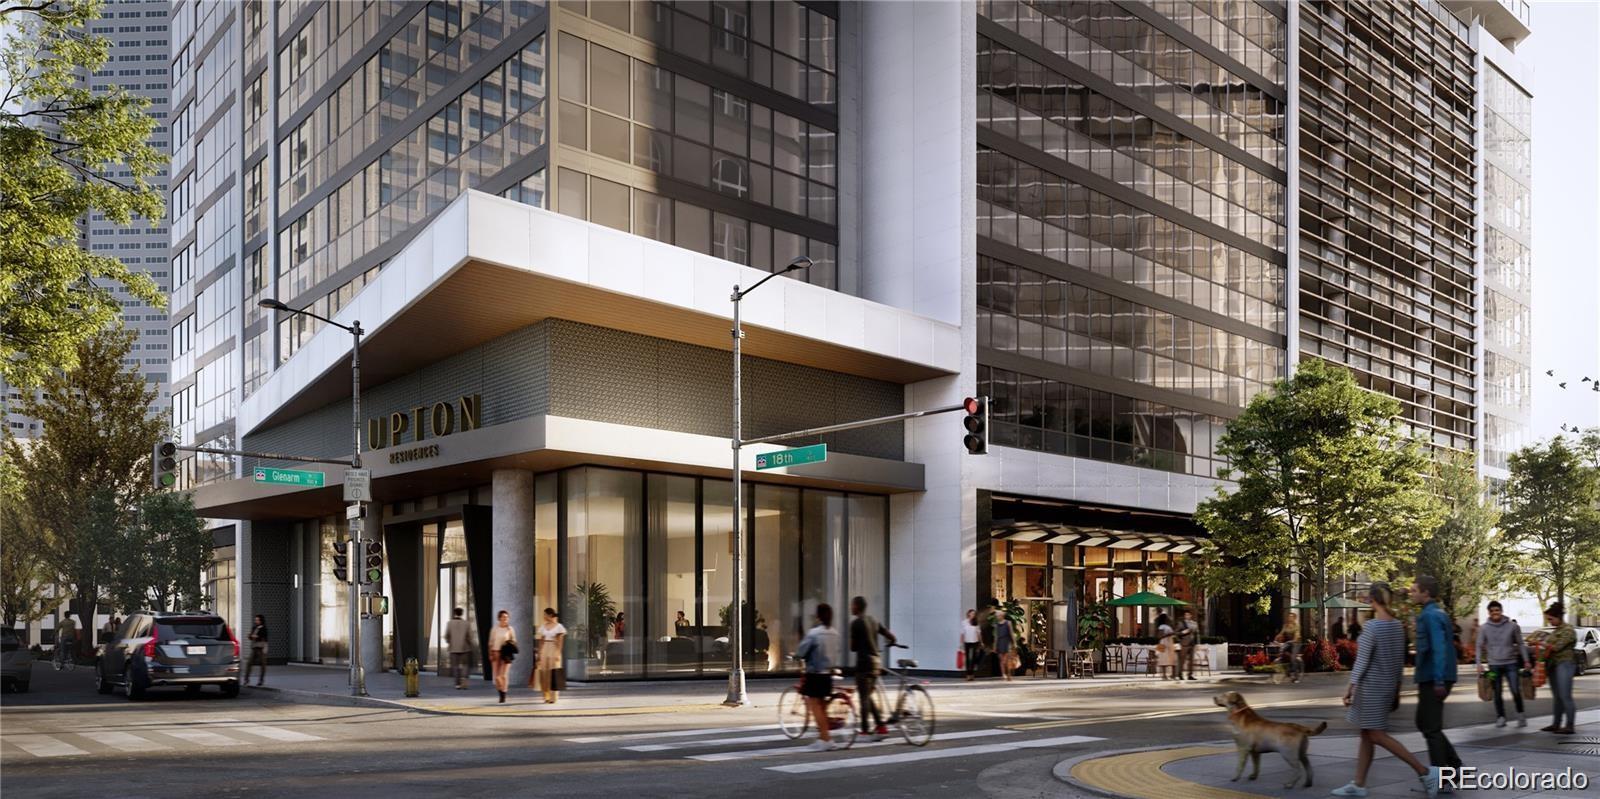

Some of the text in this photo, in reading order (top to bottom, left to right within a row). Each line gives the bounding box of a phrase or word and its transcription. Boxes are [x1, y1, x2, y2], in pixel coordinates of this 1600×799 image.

[368, 393, 481, 451] UPTON
[389, 444, 440, 464] RESIDENCES
[772, 454, 793, 465] 18th
[272, 470, 300, 483] Glenarm
